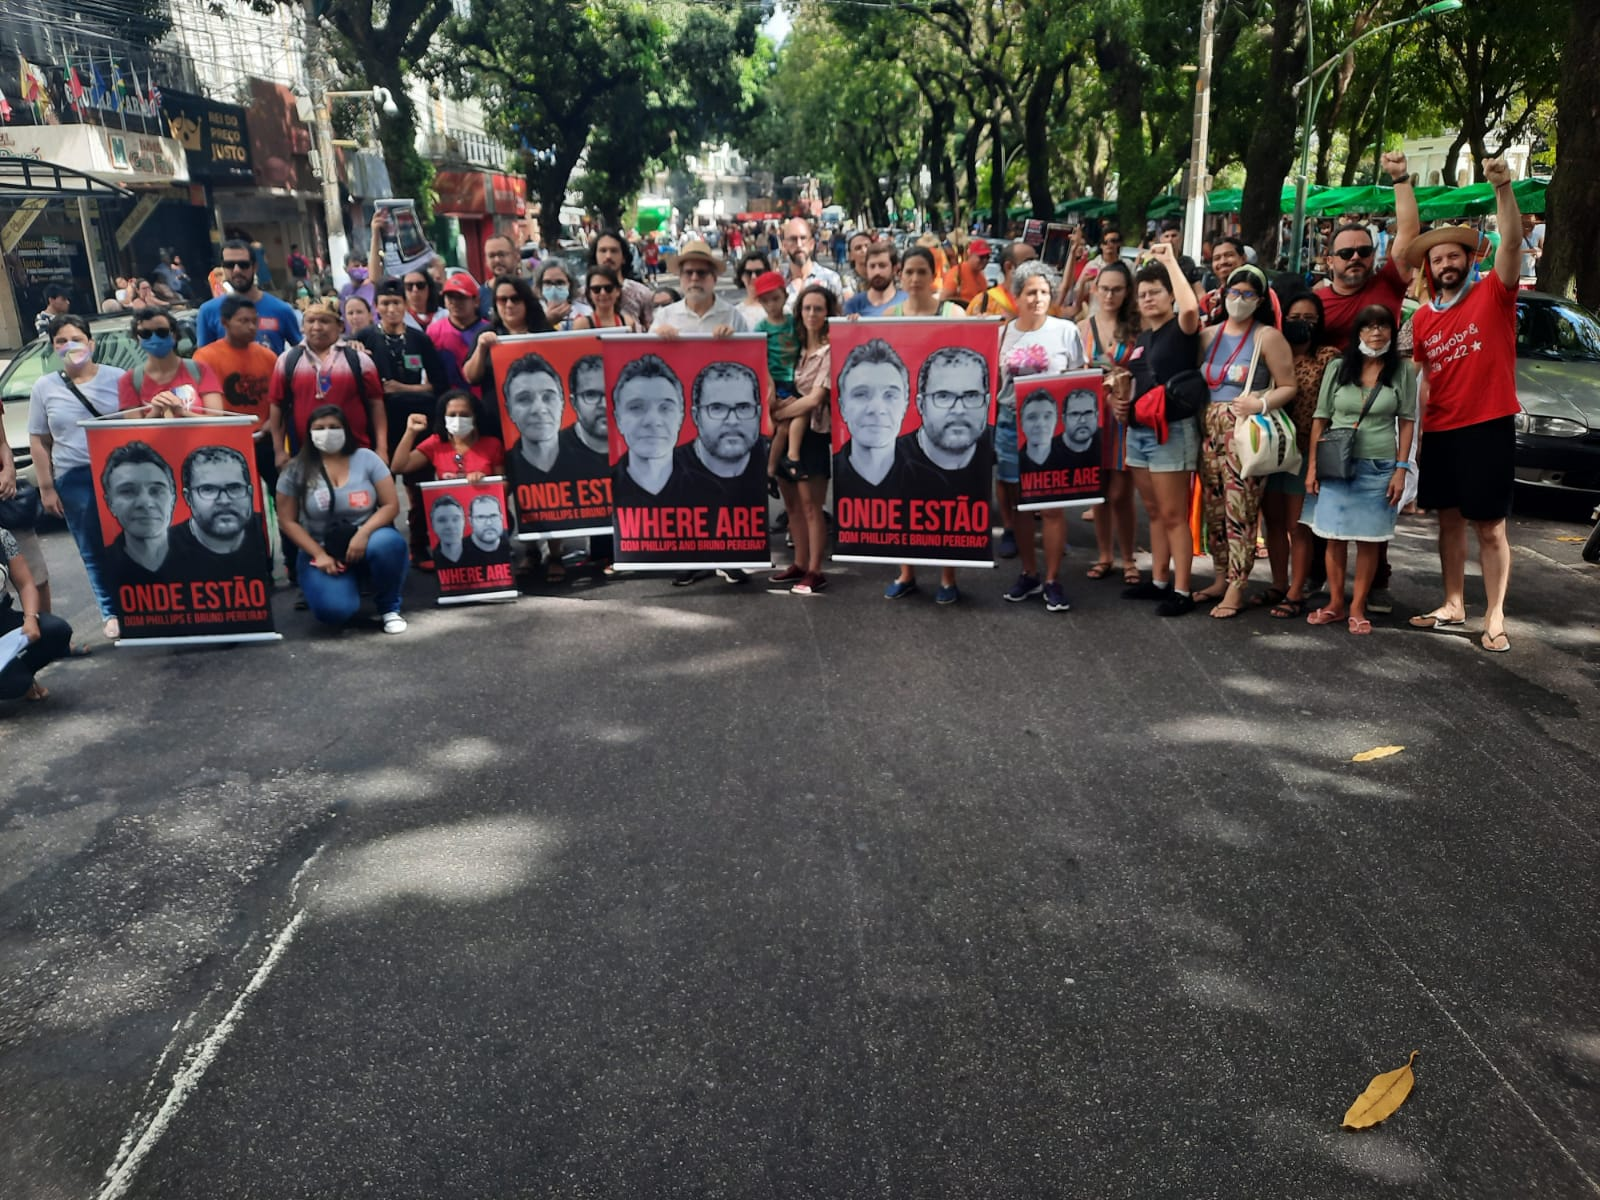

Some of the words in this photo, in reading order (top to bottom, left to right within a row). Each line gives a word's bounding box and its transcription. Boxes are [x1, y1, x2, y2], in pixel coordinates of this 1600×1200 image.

[210, 127, 240, 143] PREÇO
[211, 143, 246, 161] JUSTO
[1020, 468, 1071, 490] WHERE
[1073, 466, 1101, 486] ARE
[517, 481, 574, 510] ONDE
[576, 477, 614, 506] EST
[574, 508, 580, 519] E
[616, 506, 710, 539] WHERE
[716, 506, 766, 538] ARE
[838, 497, 903, 530] ONDE
[909, 495, 989, 533] ESTÃO
[620, 540, 639, 551] DOM
[641, 540, 677, 551] PHILLIPS
[679, 540, 696, 551] AND
[698, 540, 726, 551] BRUNO
[727, 539, 767, 550] PEREIRA?
[838, 531, 859, 543] DOM
[860, 532, 900, 545] PHILLIPS
[901, 533, 908, 545] E
[909, 534, 941, 546] BRUNO
[943, 535, 988, 548] PEREIRA?
[437, 566, 485, 584] WHERE
[486, 563, 513, 580] ARE
[119, 582, 186, 613] ONDE
[190, 575, 266, 609] ESTÃO
[124, 615, 144, 627] DOM
[146, 613, 185, 625] PHILLIPS
[187, 612, 193, 624] E
[226, 609, 268, 622] PEREIRA?
